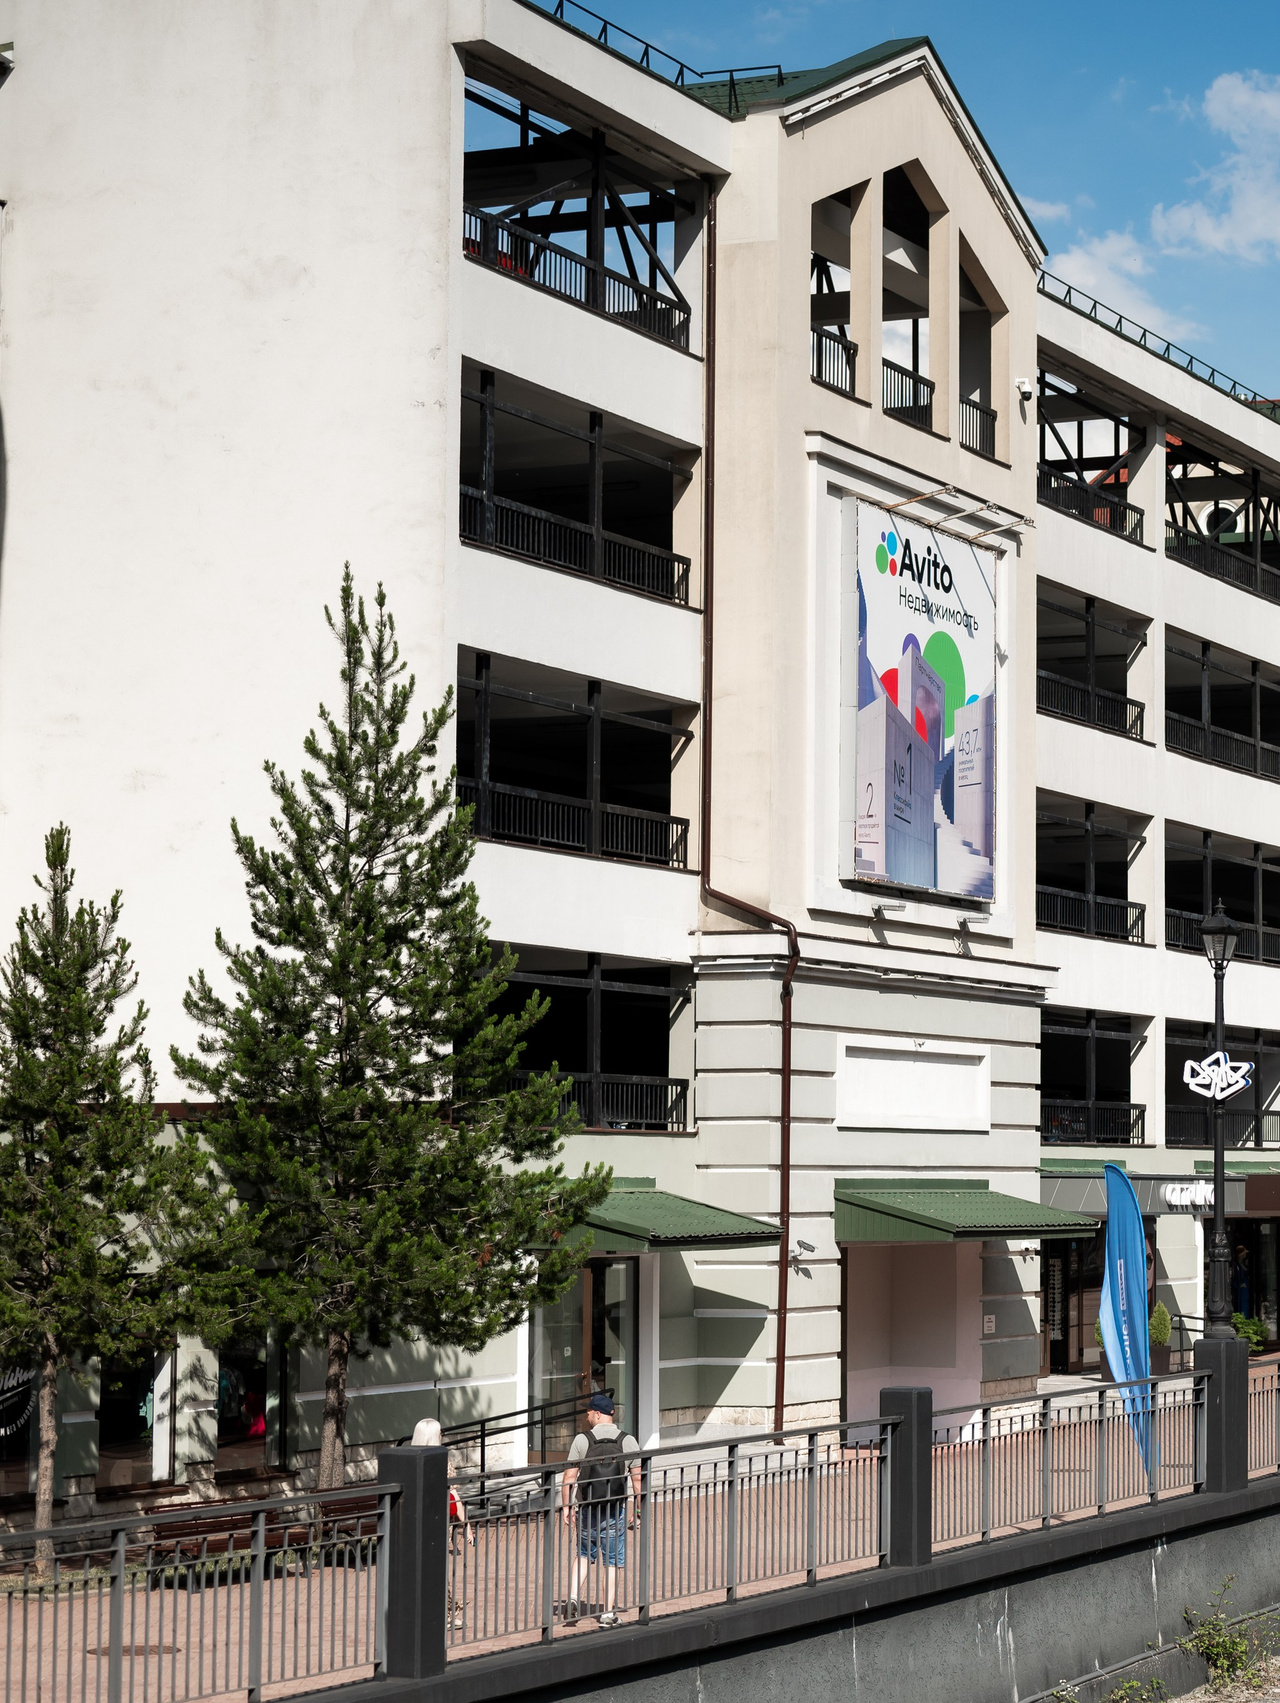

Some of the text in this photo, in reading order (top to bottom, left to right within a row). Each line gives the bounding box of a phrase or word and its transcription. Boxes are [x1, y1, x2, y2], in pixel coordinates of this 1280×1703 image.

[899, 538, 953, 593] Avito
[899, 585, 979, 631] Недвижимость
[958, 728, 978, 757] 43,7
[906, 742, 912, 795] 1
[866, 782, 873, 818] 2
